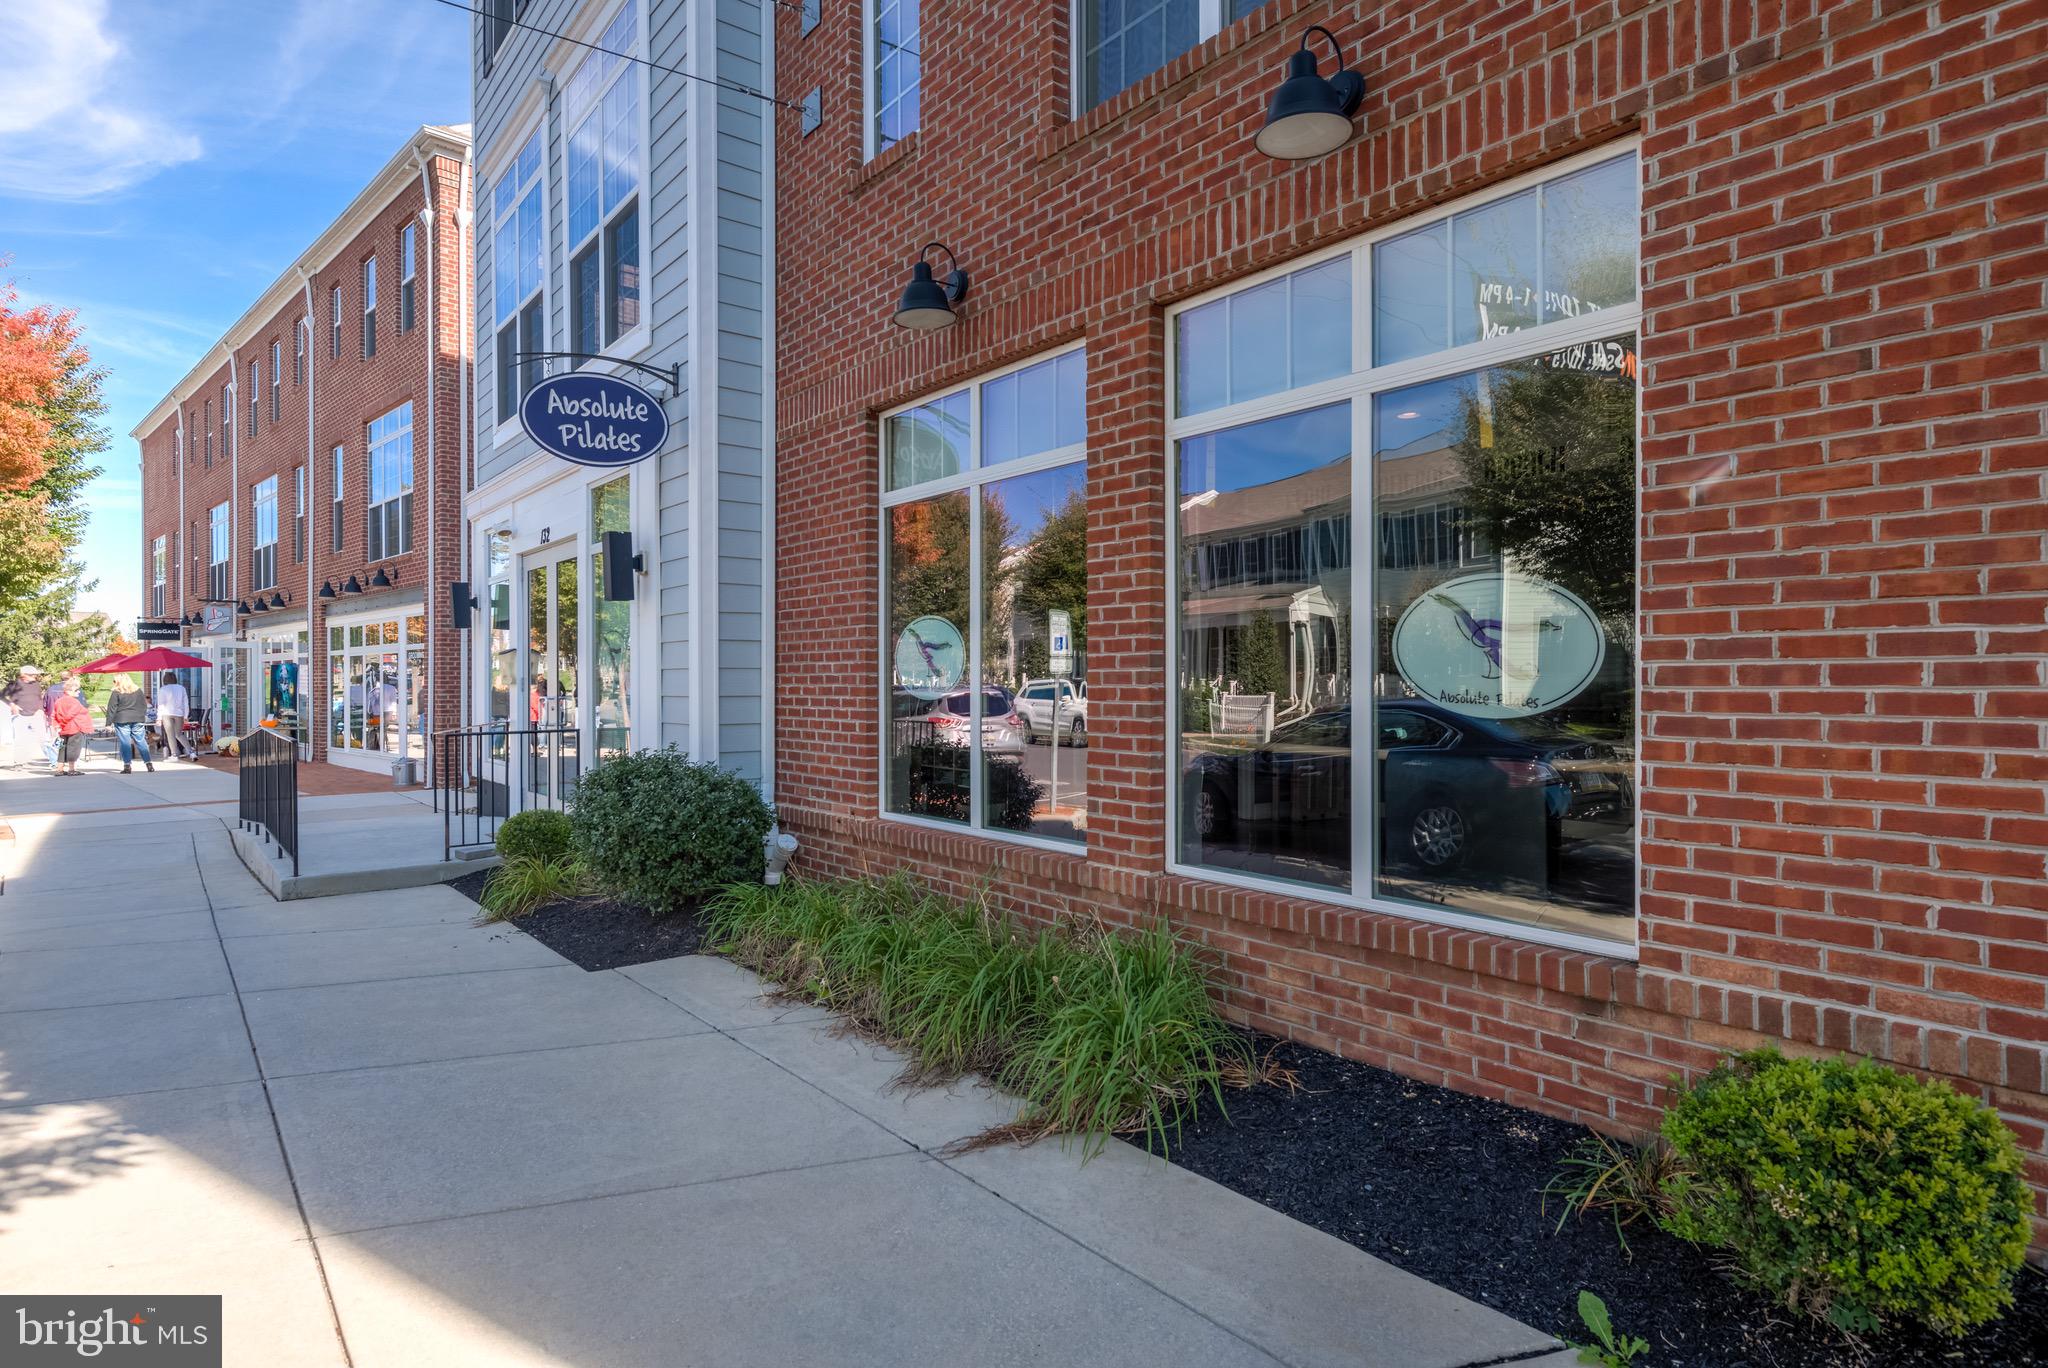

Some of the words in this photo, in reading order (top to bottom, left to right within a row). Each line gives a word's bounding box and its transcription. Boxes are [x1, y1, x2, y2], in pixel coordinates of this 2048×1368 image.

[547, 388, 649, 422] Absolute
[558, 420, 642, 453] Pilates
[540, 526, 551, 545] 132
[1439, 689, 1489, 706] Absolute
